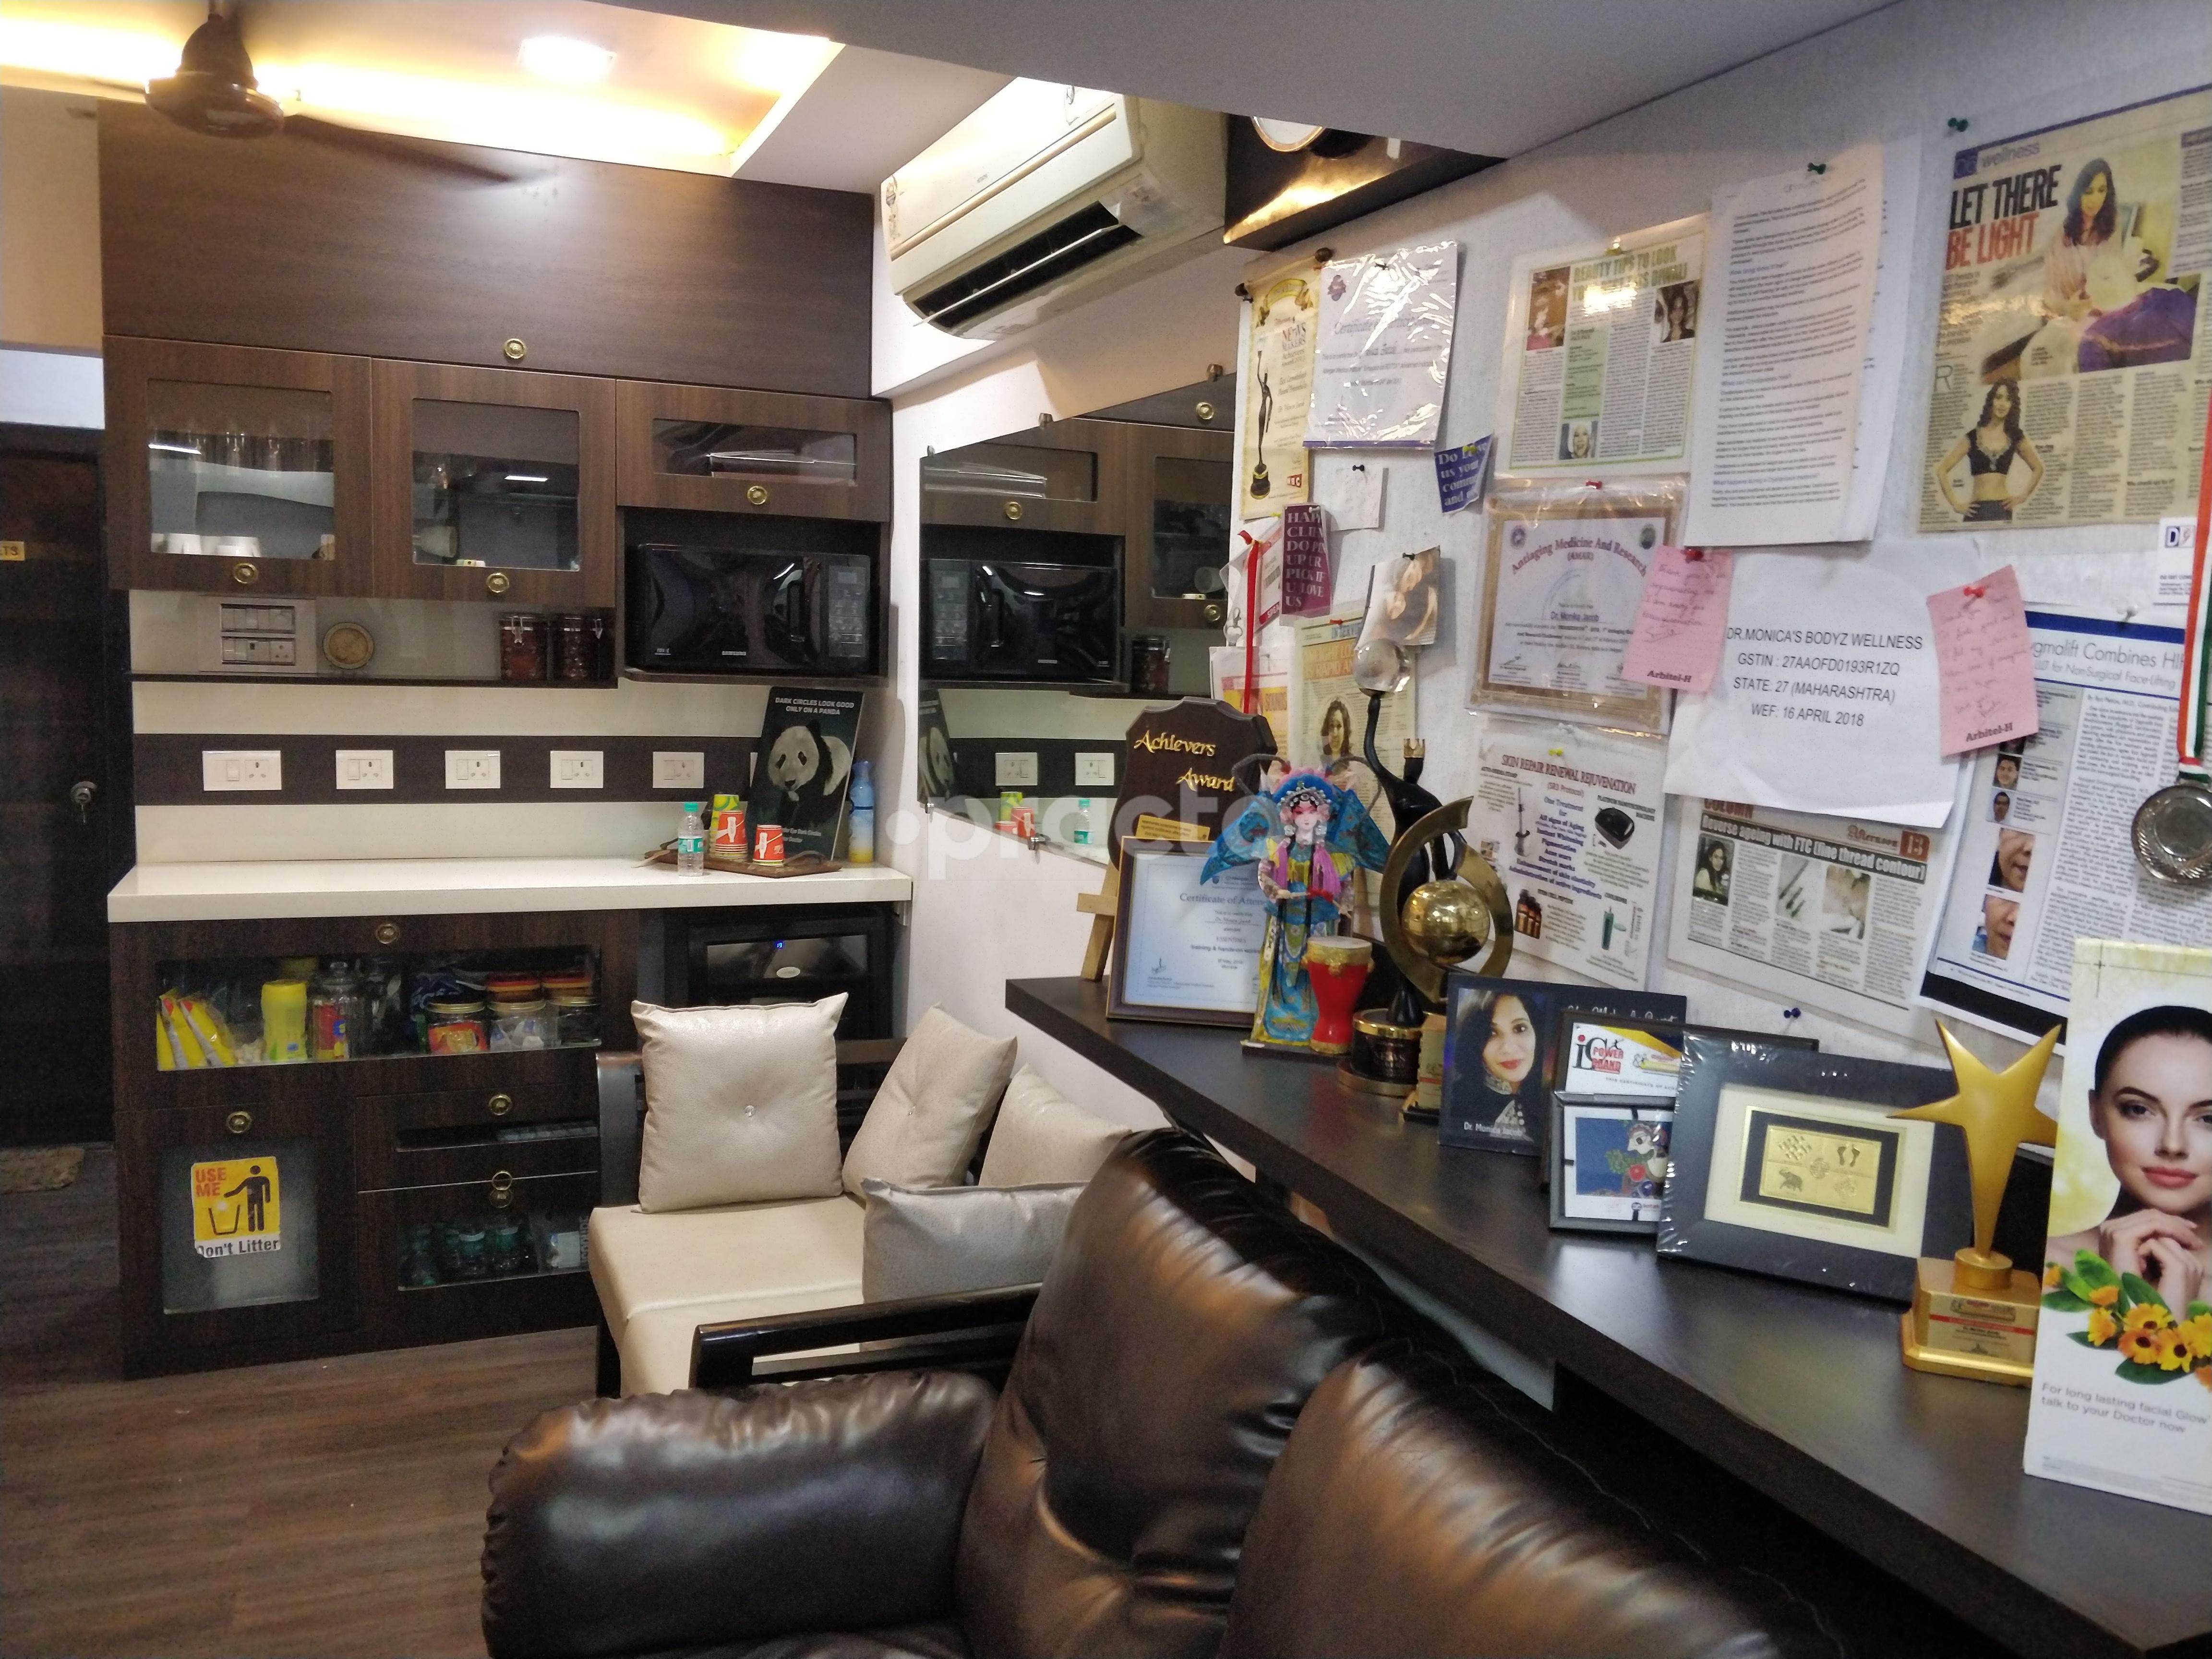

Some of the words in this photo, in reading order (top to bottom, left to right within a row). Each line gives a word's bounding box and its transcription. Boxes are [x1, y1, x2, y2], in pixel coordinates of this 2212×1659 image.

[1950, 183, 1988, 230] LET
[1992, 164, 2062, 220] THERE
[1946, 227, 1973, 270] BE
[1977, 211, 2040, 264] LIGHT
[1439, 454, 1458, 465] Do
[1441, 469, 1455, 479] us
[1444, 491, 1463, 506] and
[1286, 541, 1309, 552] DO
[1286, 554, 1306, 565] UP
[1555, 537, 1593, 550] Medicine
[1595, 538, 1612, 551] And
[1613, 542, 1647, 577] Research
[1286, 582, 1295, 593] U
[1286, 596, 1302, 607] US
[1727, 628, 1802, 643] DR.MONICA'S
[1805, 631, 1848, 646] BODYZ
[1852, 634, 1923, 649] WELLNESS
[1738, 653, 1773, 666] GSTIN
[2030, 639, 2079, 658] gmalift
[2083, 643, 2157, 668] Combines
[1647, 670, 1692, 683] Arbitel-H
[1775, 681, 1789, 693] 27
[1791, 682, 1896, 705] (MAHARASHTRA)
[1783, 707, 1795, 719] 16
[1797, 708, 1831, 723] APRIL
[1835, 712, 1864, 726] 2018
[1965, 722, 2013, 742] Arbitel-H
[1133, 730, 1217, 757] Achievers
[1176, 767, 1235, 792] Award
[1502, 755, 1519, 768] SKIN
[1520, 758, 1544, 773] REPAIR
[1545, 763, 1578, 781] RENEWAL
[1580, 771, 1636, 795] REJUVENATION
[1702, 815, 1738, 836] Reverse
[1794, 837, 1813, 854] FTC
[1838, 847, 1875, 869] thread
[1180, 892, 1225, 903] Certificate
[1227, 896, 1236, 904] of
[195, 1167, 227, 1184] USE
[195, 1182, 221, 1198] ME
[239, 1239, 279, 1253] Litter
[2042, 1382, 2063, 1395] For
[2066, 1387, 2092, 1402] long
[2095, 1393, 2136, 1410] lasting
[2140, 1402, 2172, 1417] facial
[2041, 1396, 2063, 1408] talk
[2067, 1400, 2079, 1411] to
[2082, 1405, 2110, 1417] your
[2113, 1410, 2156, 1427] Doctor
[2160, 1421, 2186, 1433] now
